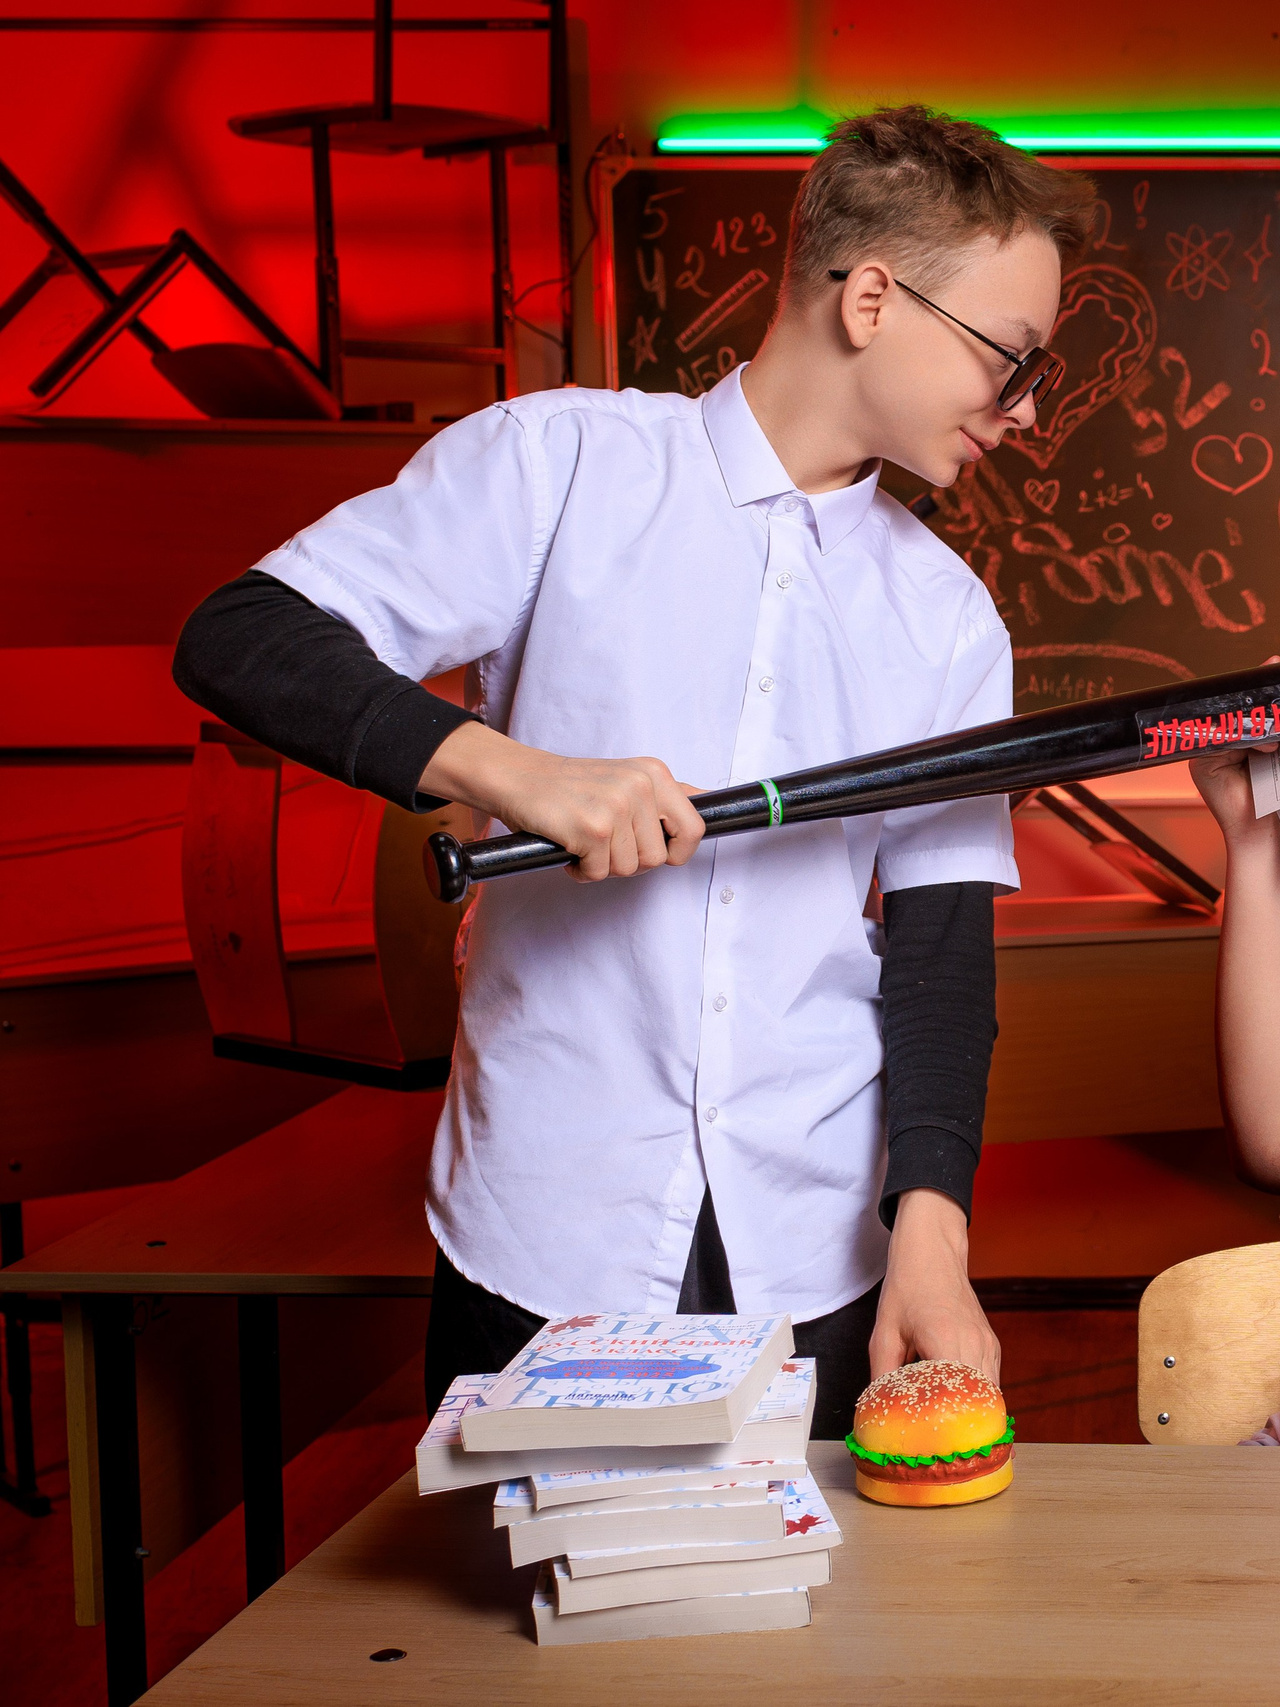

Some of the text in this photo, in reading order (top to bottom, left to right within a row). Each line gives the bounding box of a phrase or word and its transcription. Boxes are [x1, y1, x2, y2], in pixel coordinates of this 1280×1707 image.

[642, 187, 685, 239] 5
[711, 212, 777, 257] 123
[675, 245, 711, 299] 2
[1144, 710, 1244, 760] ПРАВДЕ
[1250, 705, 1267, 738] В
[536, 1338, 758, 1351] РУССКИЙ ЯЗЫК
